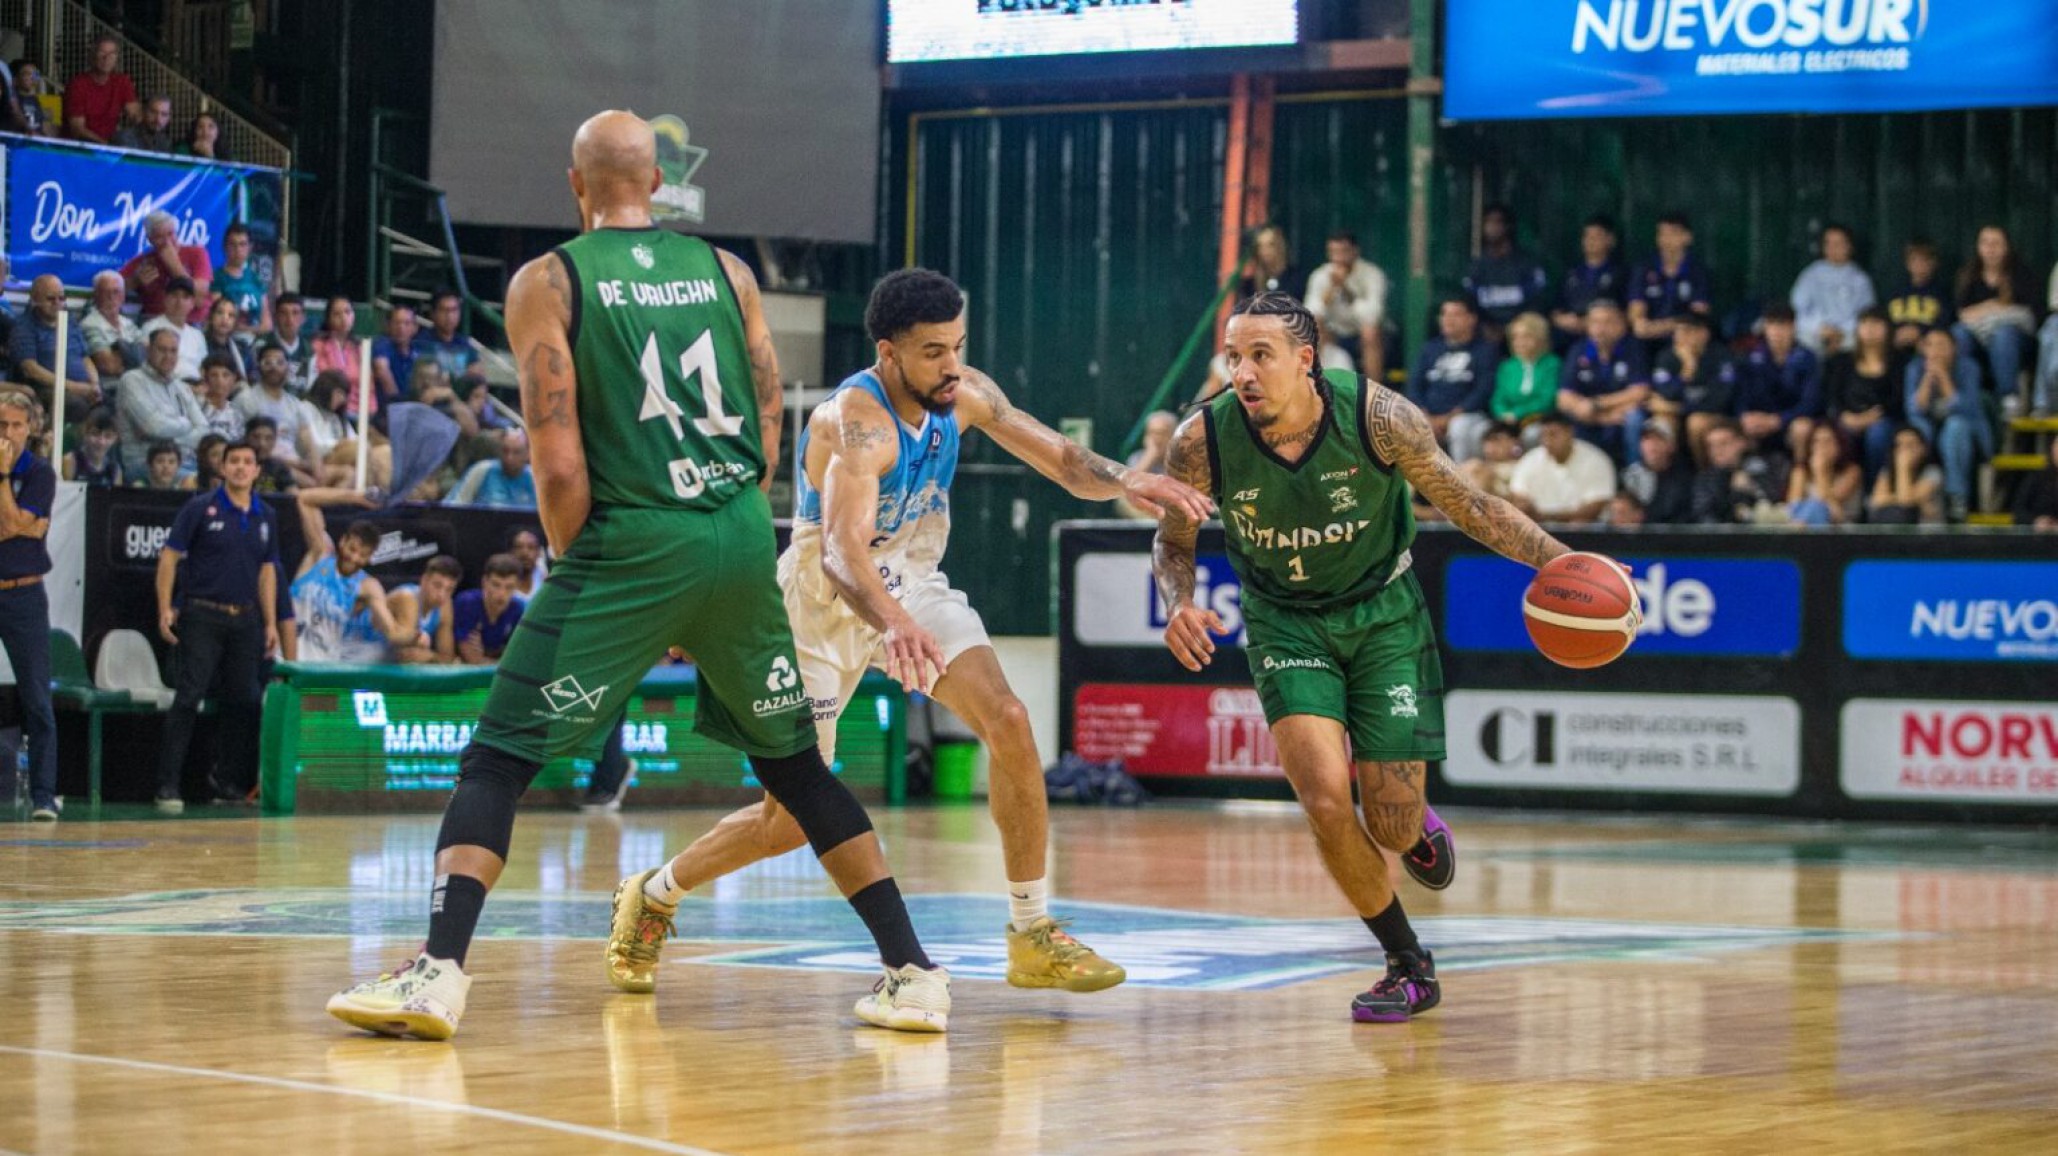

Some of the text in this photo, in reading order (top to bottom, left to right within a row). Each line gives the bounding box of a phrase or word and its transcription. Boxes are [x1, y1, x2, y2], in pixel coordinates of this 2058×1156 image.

[1571, 0, 1910, 53] NUEVOSUR
[1696, 47, 1910, 76] MATERIALES ELECTRICOS
[31, 180, 209, 252] Don Mio
[597, 279, 718, 308] DE VAUGHN
[639, 328, 744, 441] 41
[1288, 555, 1310, 581] 1
[1910, 600, 2058, 641] NUEVO
[385, 721, 478, 753] MARBA
[1478, 706, 1557, 770] CI
[1567, 712, 1745, 736] construcciones
[1568, 748, 1682, 770] integrales
[1899, 768, 2017, 787] ALQUILER
